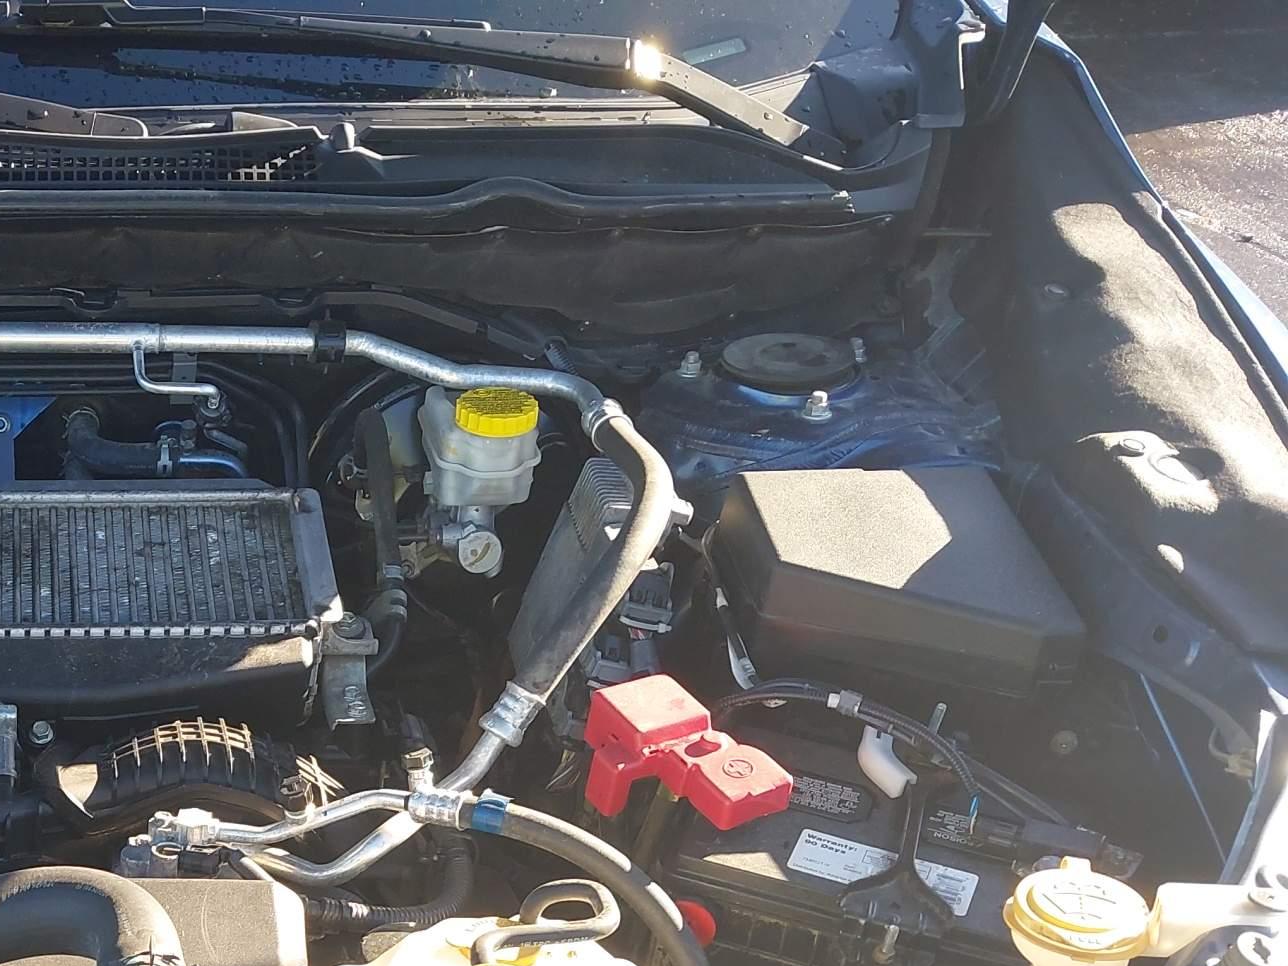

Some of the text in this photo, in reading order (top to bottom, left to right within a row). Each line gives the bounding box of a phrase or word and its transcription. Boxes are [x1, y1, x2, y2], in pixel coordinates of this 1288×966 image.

[804, 839, 847, 855] 90 Days
[806, 832, 857, 852] Warranty:
